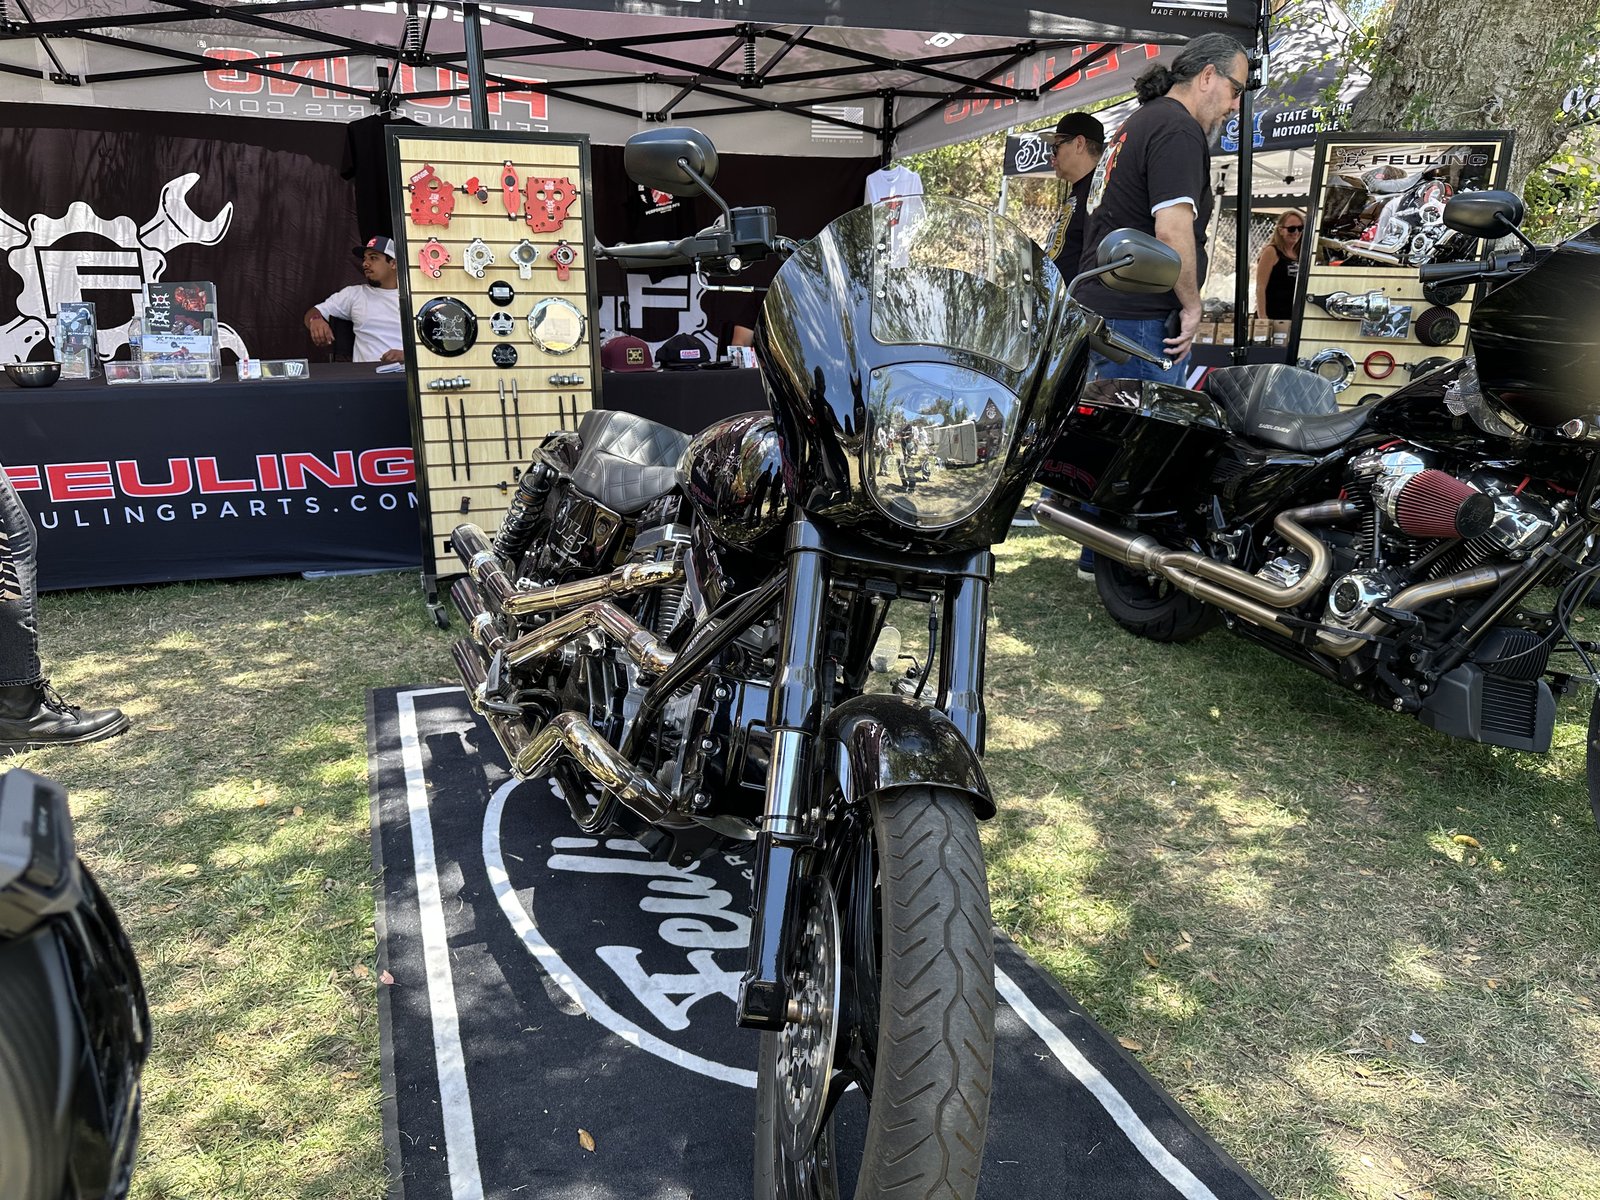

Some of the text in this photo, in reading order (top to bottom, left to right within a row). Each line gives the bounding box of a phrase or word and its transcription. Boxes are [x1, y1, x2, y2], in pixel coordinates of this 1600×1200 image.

[1150, 8, 1173, 16] MADE
[1191, 11, 1228, 19] AMERICA
[1275, 109, 1308, 123] STATE
[1371, 153, 1489, 167] FEULING
[2, 446, 417, 504] FEULING
